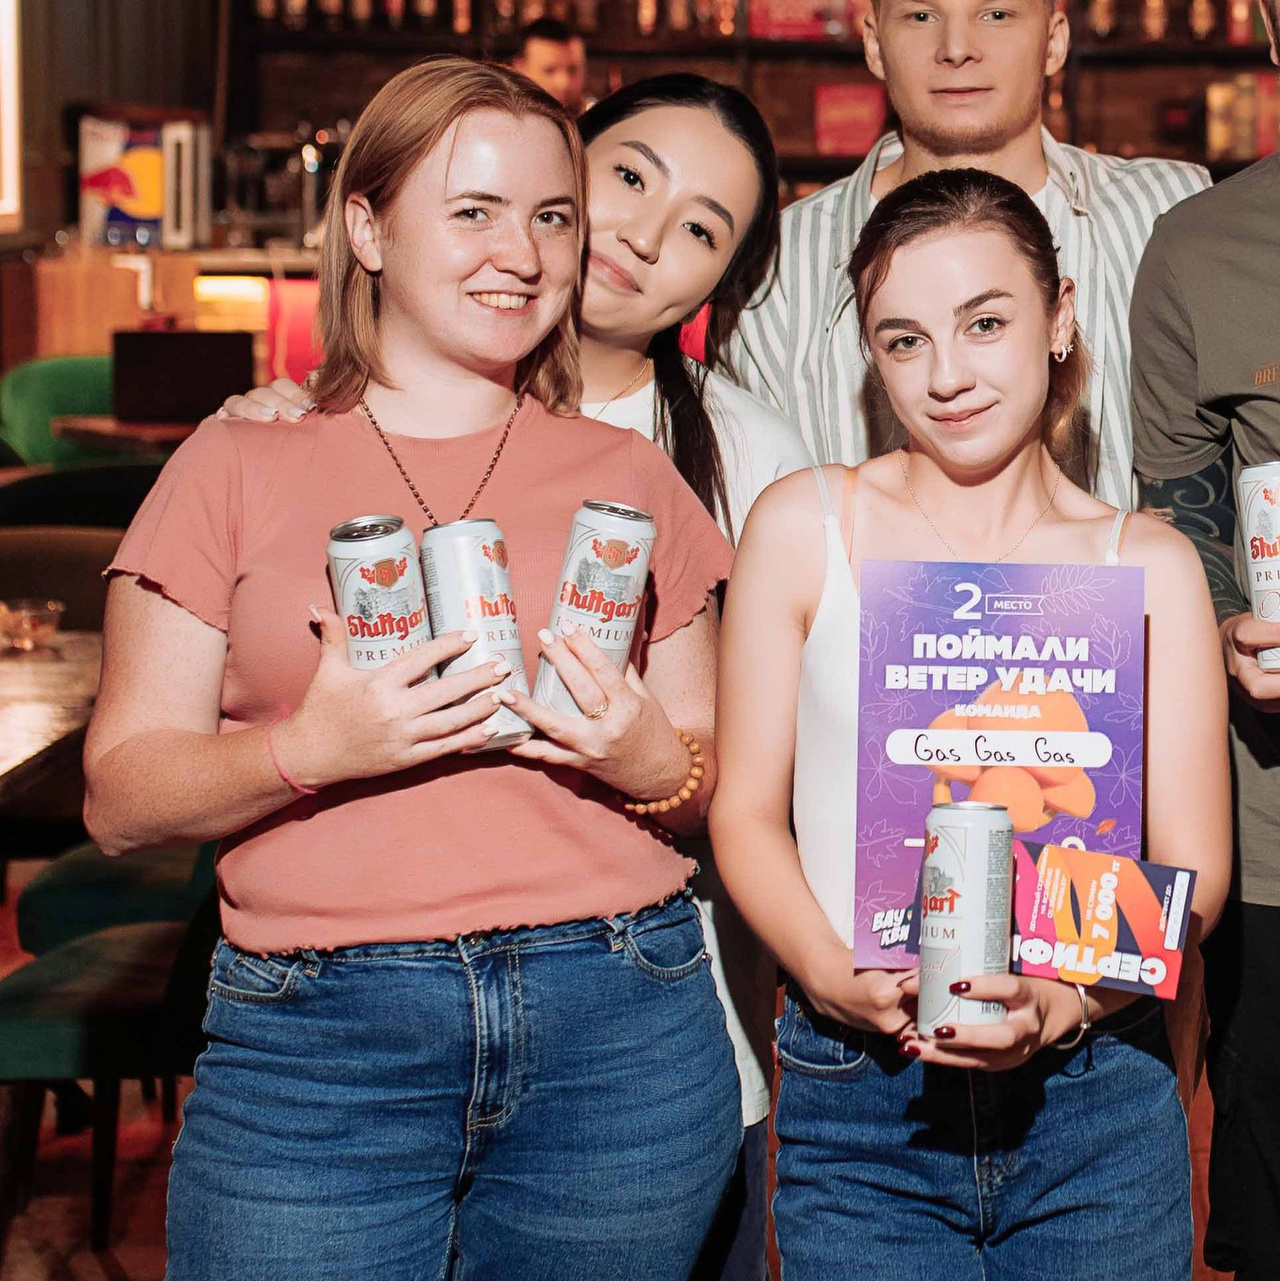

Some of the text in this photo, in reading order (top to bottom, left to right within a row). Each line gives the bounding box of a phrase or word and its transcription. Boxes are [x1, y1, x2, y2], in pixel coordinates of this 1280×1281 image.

[953, 582, 1032, 620] 2 МЕСТО
[913, 628, 1089, 662] ПОЙМАЛИ
[885, 664, 1116, 695] ВЕТЕР УДАЧИ
[954, 704, 1041, 718] КОМАНДА
[914, 733, 1075, 764] Gas Gas Gas
[880, 924, 911, 948] КВИ
[1091, 923, 1109, 940] 7
